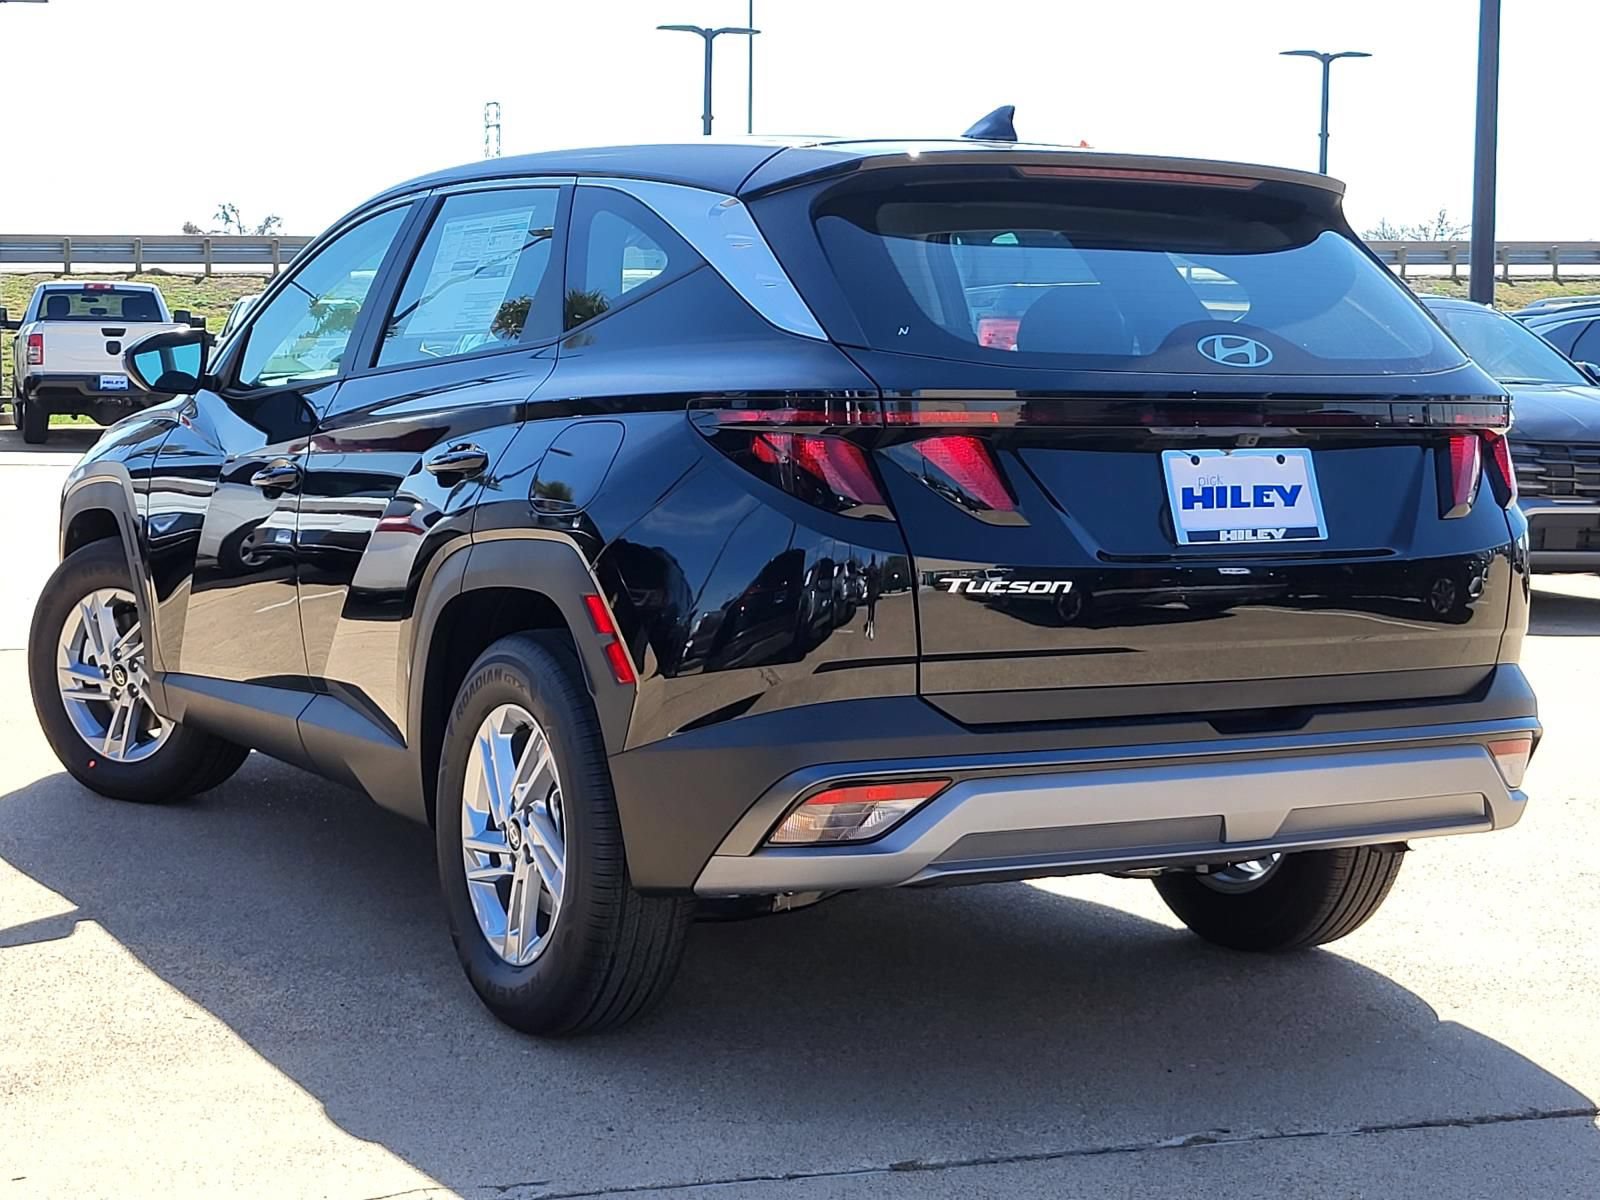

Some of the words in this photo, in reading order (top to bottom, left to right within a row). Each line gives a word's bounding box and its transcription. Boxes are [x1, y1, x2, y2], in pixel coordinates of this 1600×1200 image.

[1181, 485, 1303, 511] HILEY
[1219, 528, 1287, 542] HILEY
[939, 578, 1073, 594] Tucson
[456, 668, 503, 720] ROADIAN
